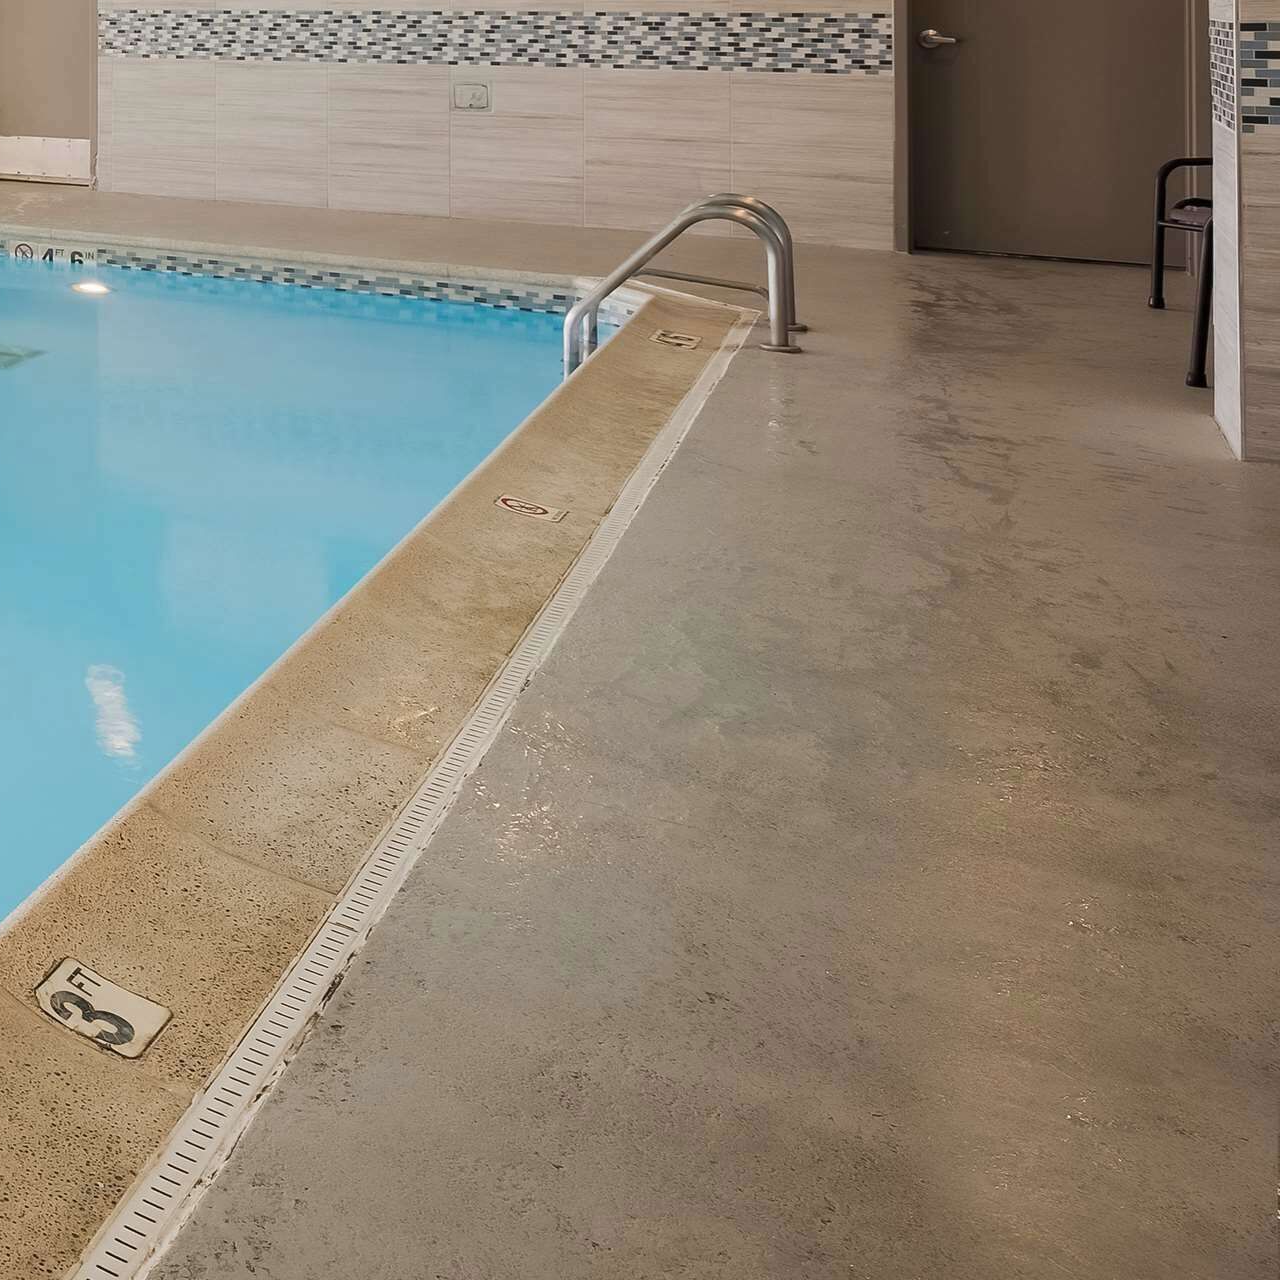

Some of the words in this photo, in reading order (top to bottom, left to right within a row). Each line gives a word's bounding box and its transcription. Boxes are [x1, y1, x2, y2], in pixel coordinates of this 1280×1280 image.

[55, 249, 65, 257] FT
[70, 251, 84, 265] 6
[85, 251, 95, 260] IN
[66, 967, 102, 997] FT
[50, 990, 136, 1046] 3
